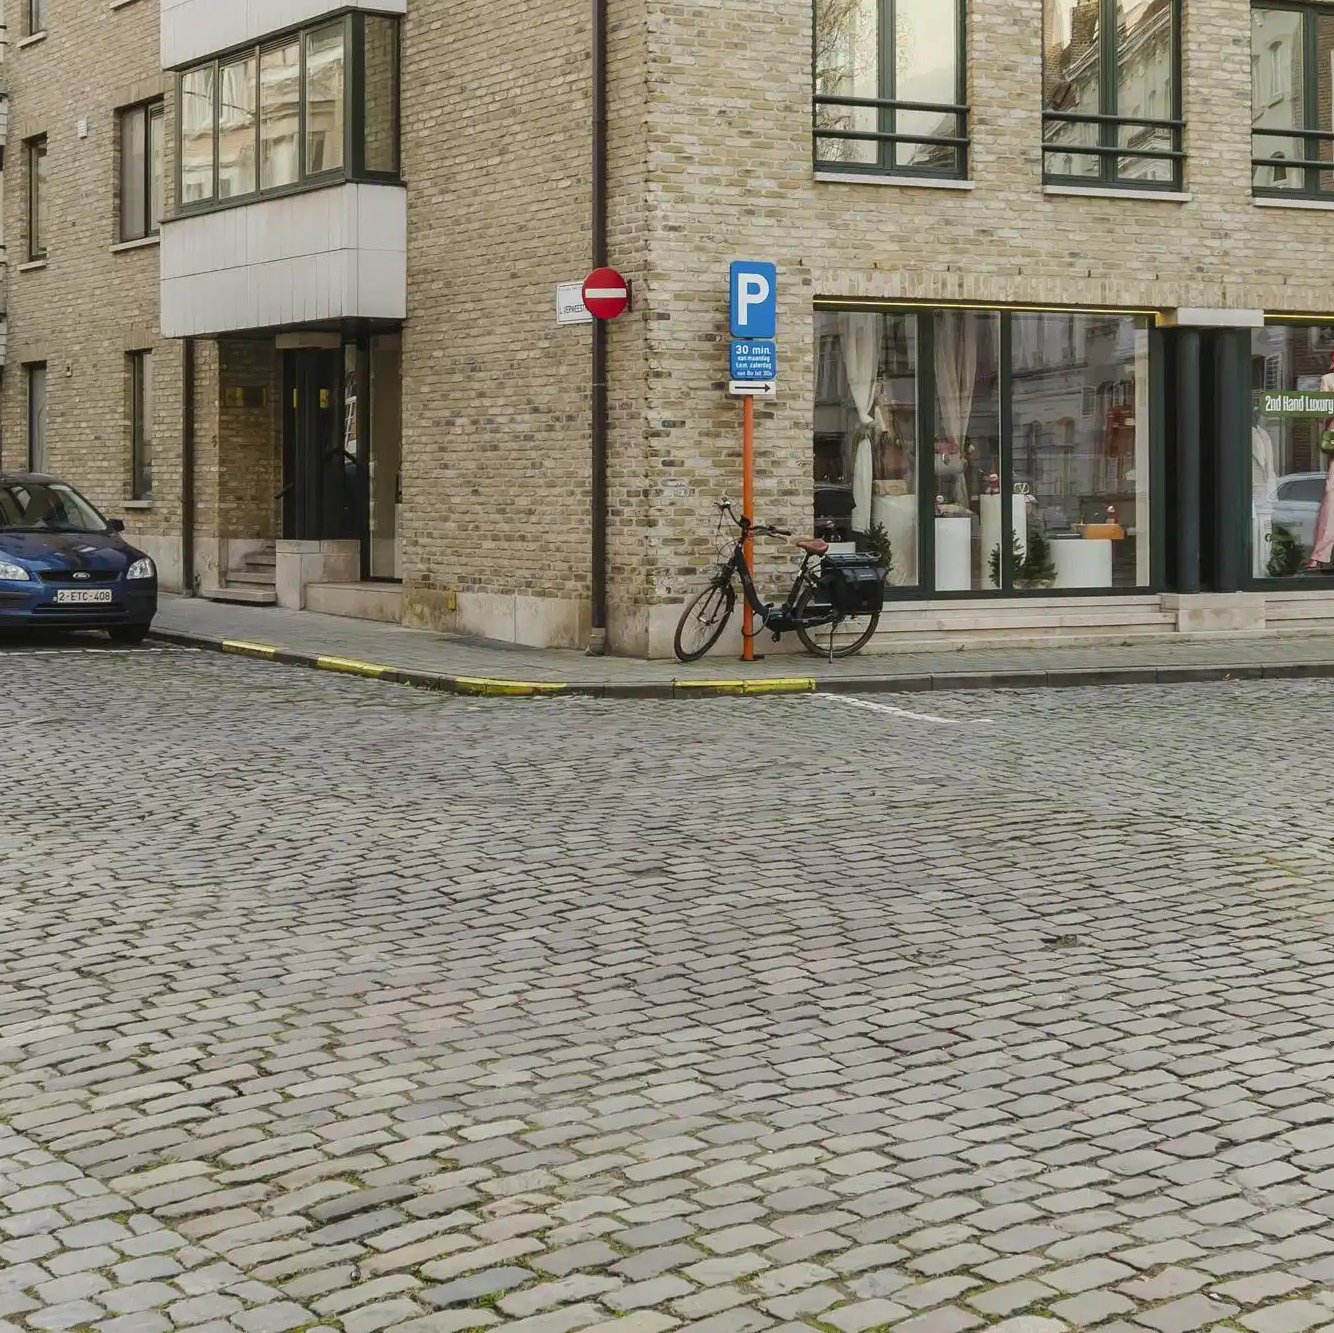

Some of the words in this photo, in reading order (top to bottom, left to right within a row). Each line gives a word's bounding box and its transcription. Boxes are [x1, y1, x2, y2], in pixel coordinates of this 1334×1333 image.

[738, 272, 769, 326] P
[735, 345, 749, 355] 30
[1265, 395, 1281, 412] 2nd
[1283, 395, 1304, 412] Hand
[1306, 395, 1334, 414] Luxury
